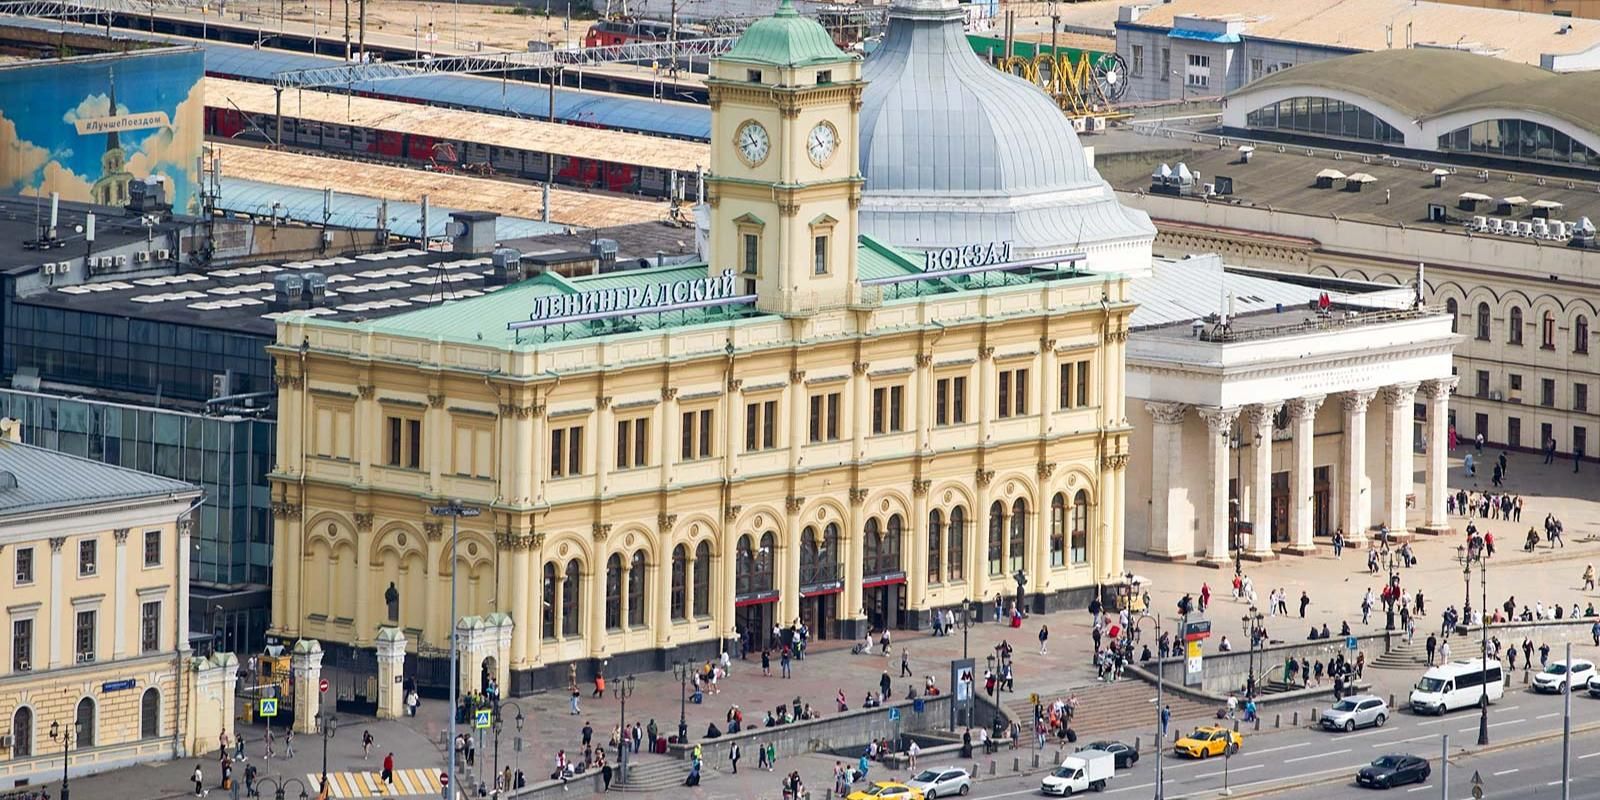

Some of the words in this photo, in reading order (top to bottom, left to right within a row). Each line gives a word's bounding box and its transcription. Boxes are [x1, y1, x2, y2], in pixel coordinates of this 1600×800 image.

[86, 117, 161, 131] #ЛучшеПоездом
[530, 269, 737, 320] ЛЕНИНГРАДСКИЙ
[925, 241, 1014, 272] ВОКЗАЛ
[961, 669, 973, 681] М
